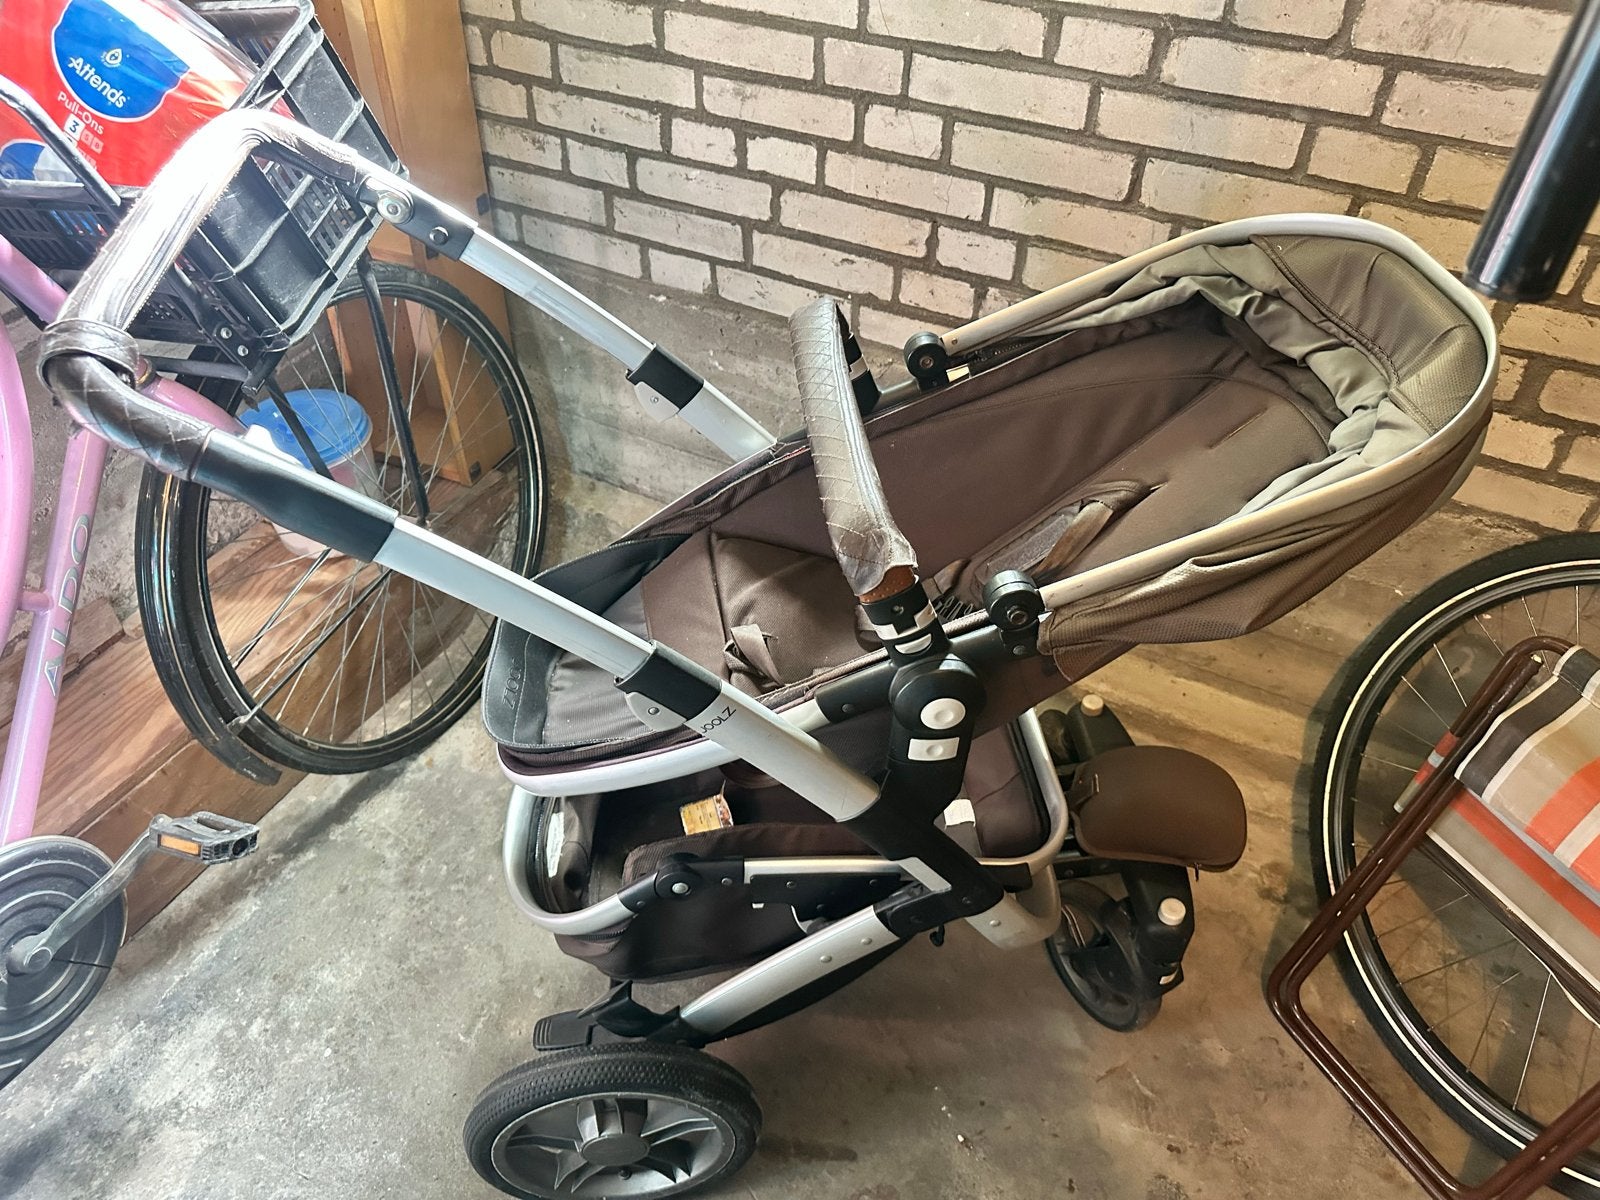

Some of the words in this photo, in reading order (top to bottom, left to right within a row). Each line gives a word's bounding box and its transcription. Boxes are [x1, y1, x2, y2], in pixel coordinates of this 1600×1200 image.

[67, 57, 127, 109] Attends
[57, 91, 104, 135] Pull-Ons
[69, 120, 80, 134] 3
[44, 514, 90, 697] ALDO
[700, 706, 737, 734] JOOLZ
